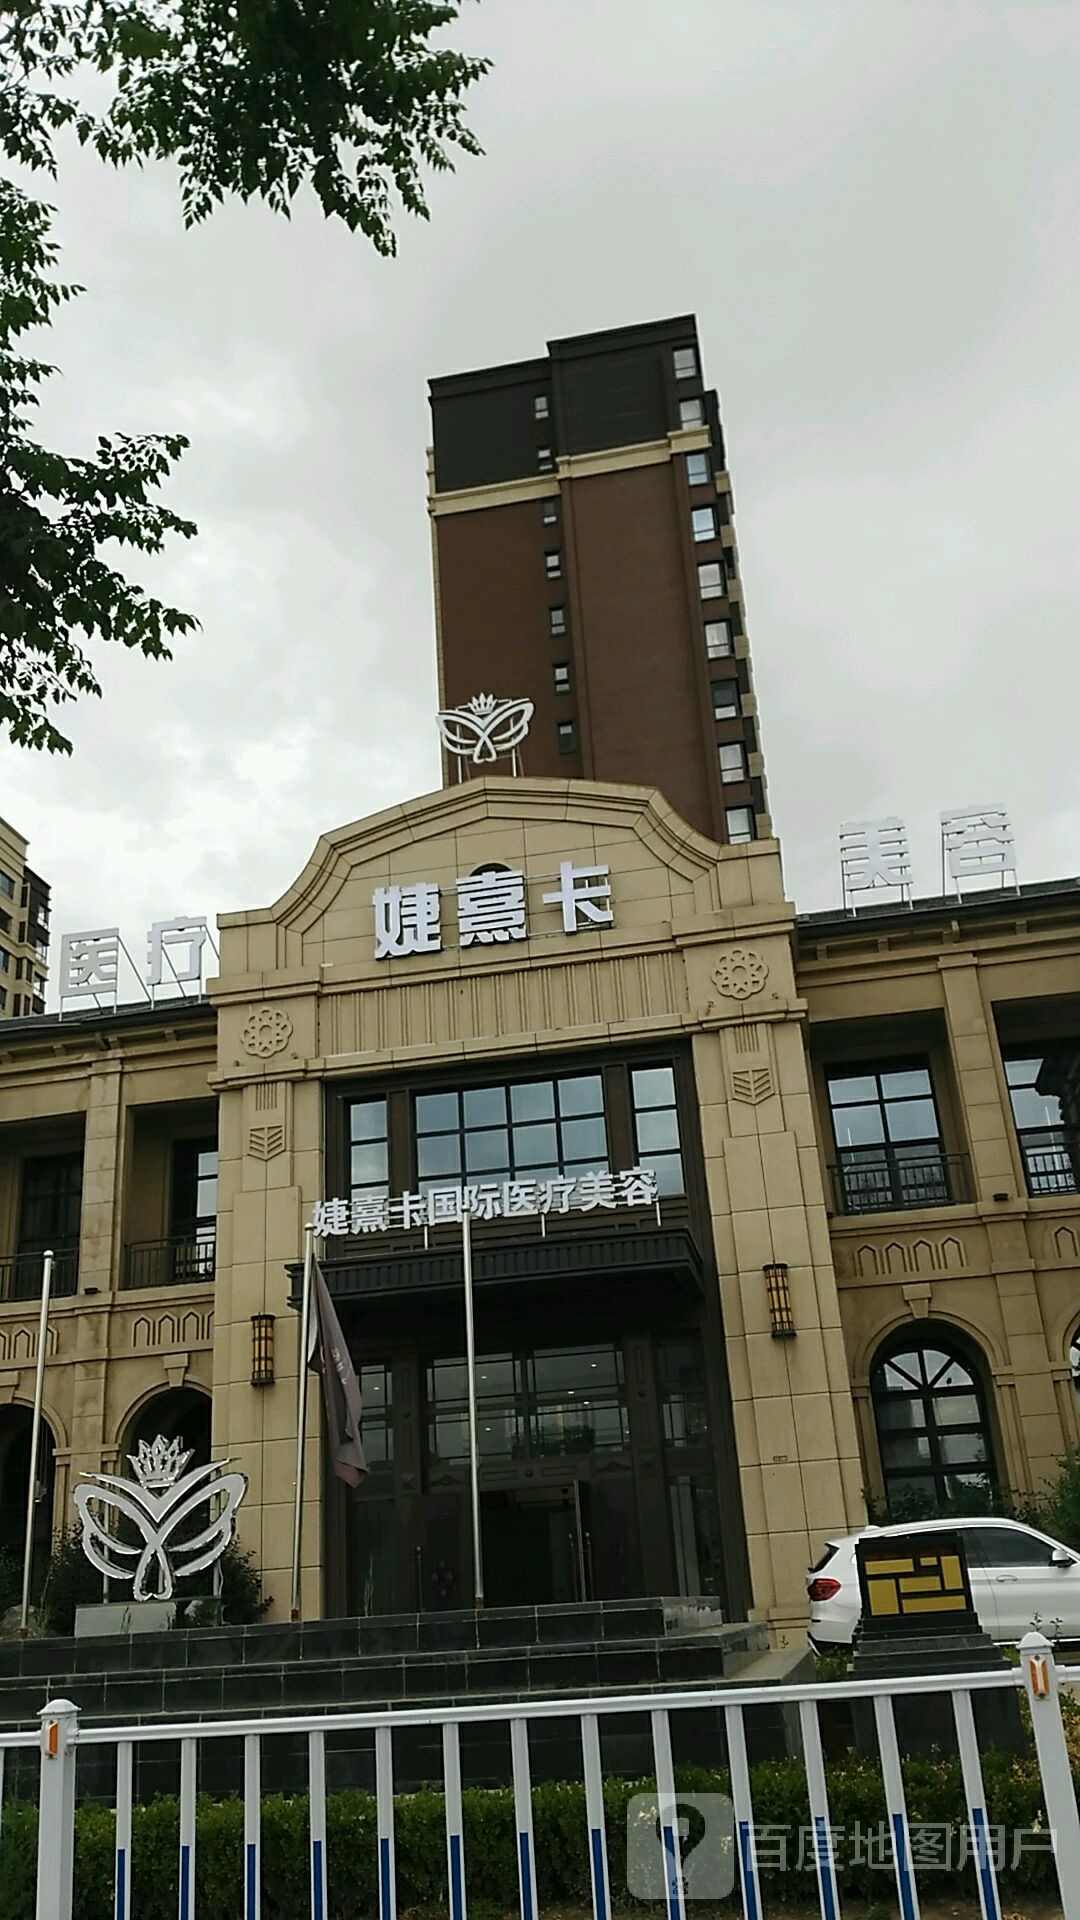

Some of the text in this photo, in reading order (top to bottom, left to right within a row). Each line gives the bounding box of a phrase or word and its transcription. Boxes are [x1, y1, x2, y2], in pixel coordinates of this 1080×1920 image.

[839, 803, 1017, 891] 美容
[373, 861, 614, 959] 婕熹卡
[59, 916, 207, 997] 医疗
[312, 1167, 658, 1237] 婕熹卡国际医疗美容
